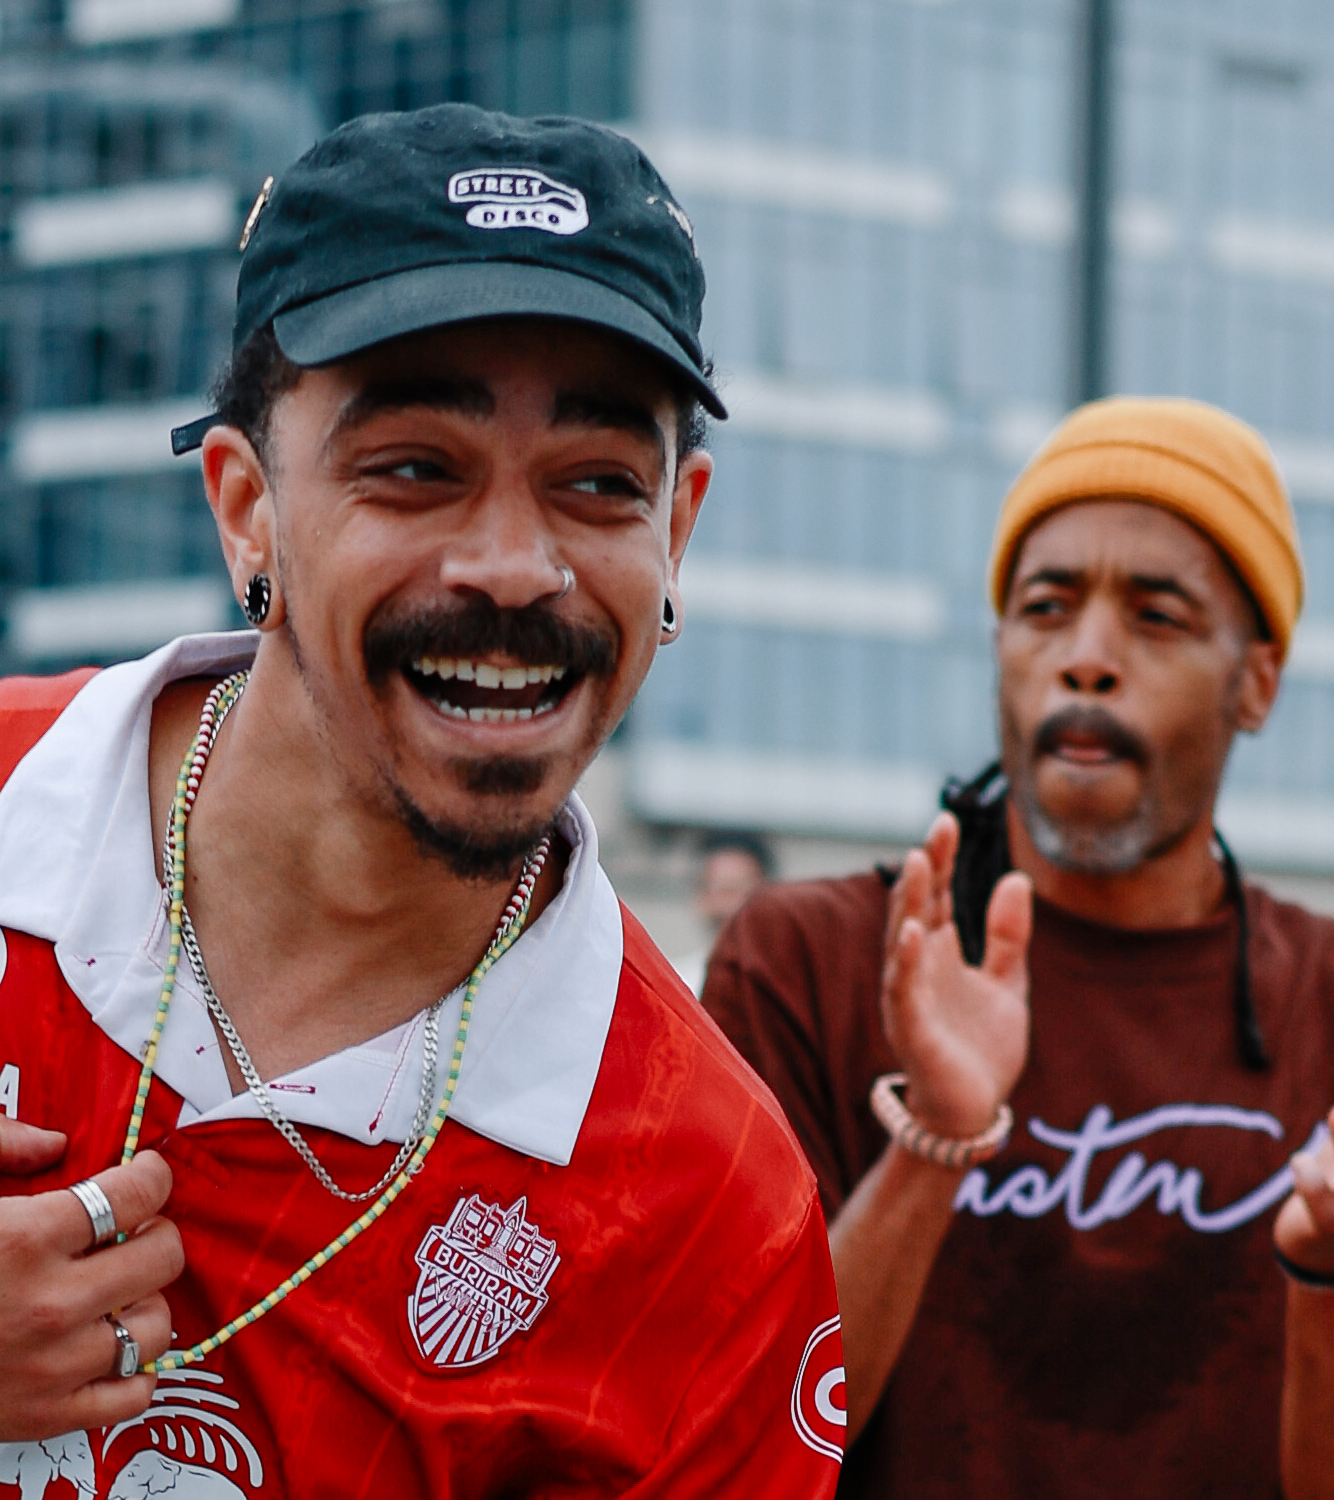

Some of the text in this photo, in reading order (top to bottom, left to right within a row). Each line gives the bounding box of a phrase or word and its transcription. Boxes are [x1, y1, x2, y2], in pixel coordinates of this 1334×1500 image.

[456, 176, 542, 197] STREET
[482, 209, 560, 225] DISCO
[433, 1243, 532, 1317] BURIRAM
[442, 1283, 495, 1327] UNITED
